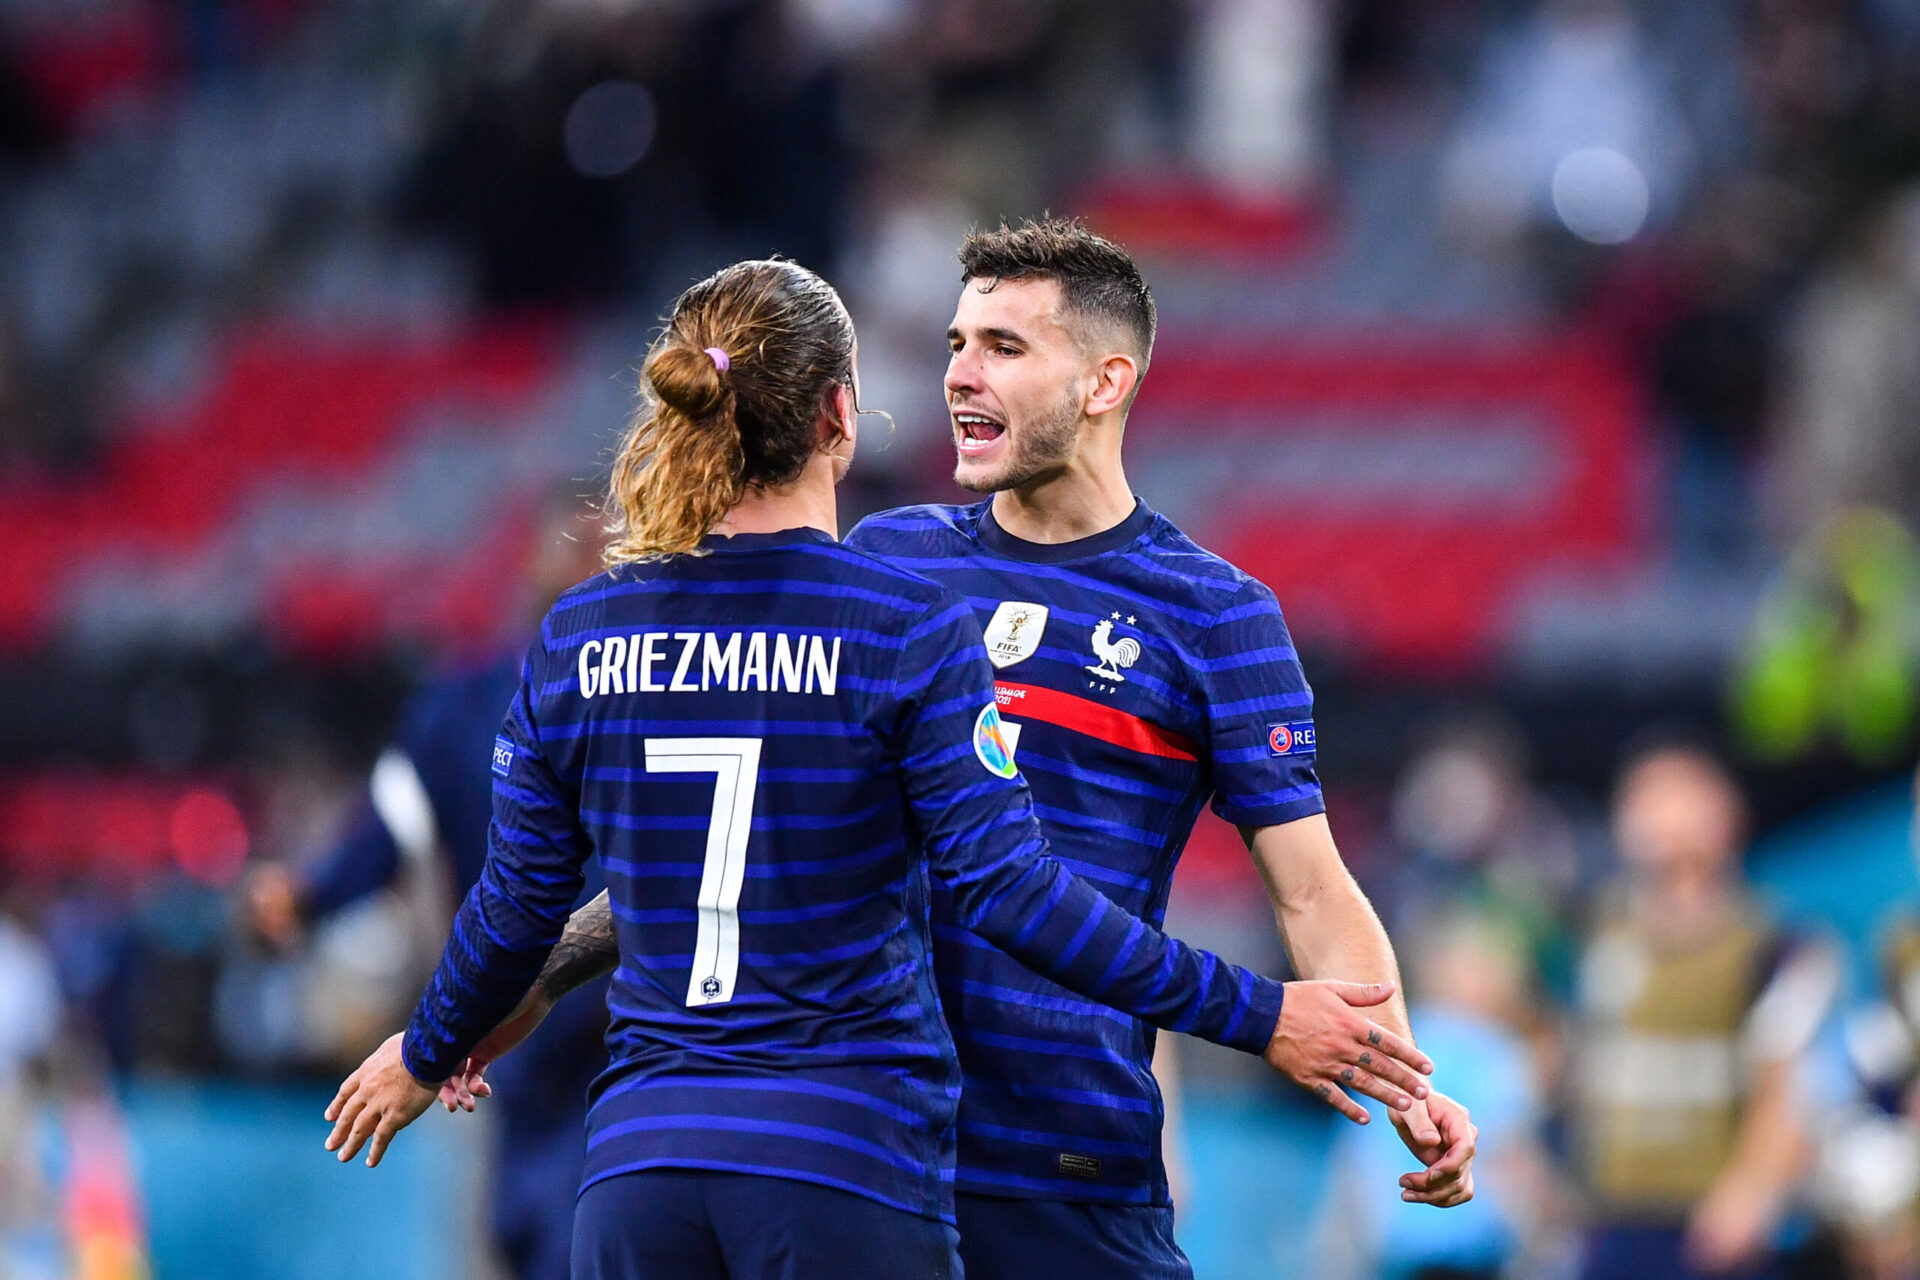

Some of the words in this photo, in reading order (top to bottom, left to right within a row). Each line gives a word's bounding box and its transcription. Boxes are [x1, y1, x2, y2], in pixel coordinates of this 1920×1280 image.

[578, 632, 841, 699] GRIEZMANN
[997, 642, 1019, 653] FIFA
[645, 738, 762, 1007] 7
